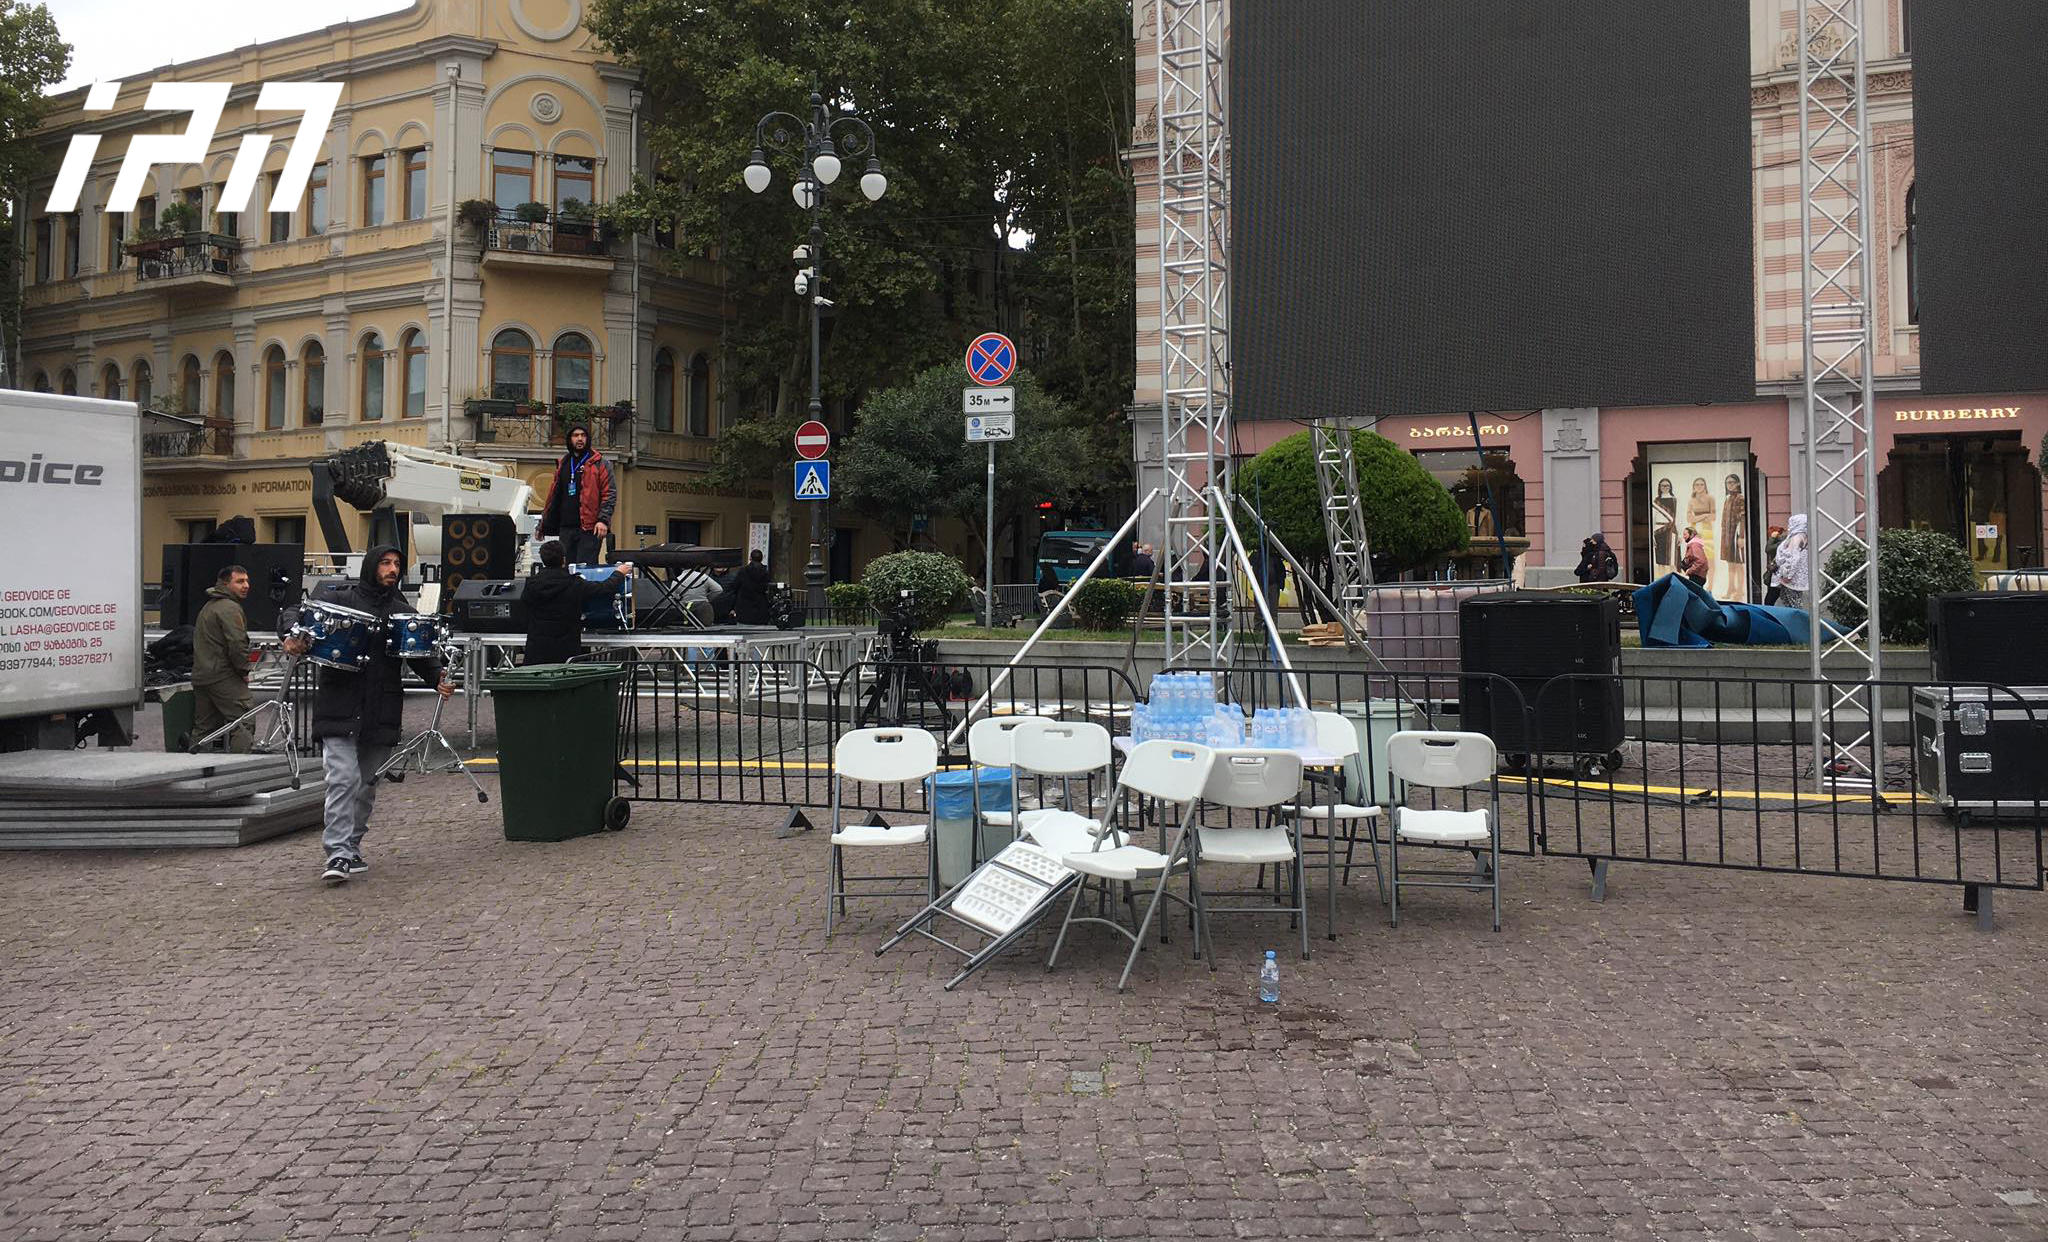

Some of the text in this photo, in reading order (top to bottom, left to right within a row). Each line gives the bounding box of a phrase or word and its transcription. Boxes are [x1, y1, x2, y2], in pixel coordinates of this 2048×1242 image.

[1895, 407, 2021, 421] BURBERRY
[252, 480, 311, 494] INFORMATION
[90, 637, 103, 648] 25
[58, 652, 113, 666] 593276271
